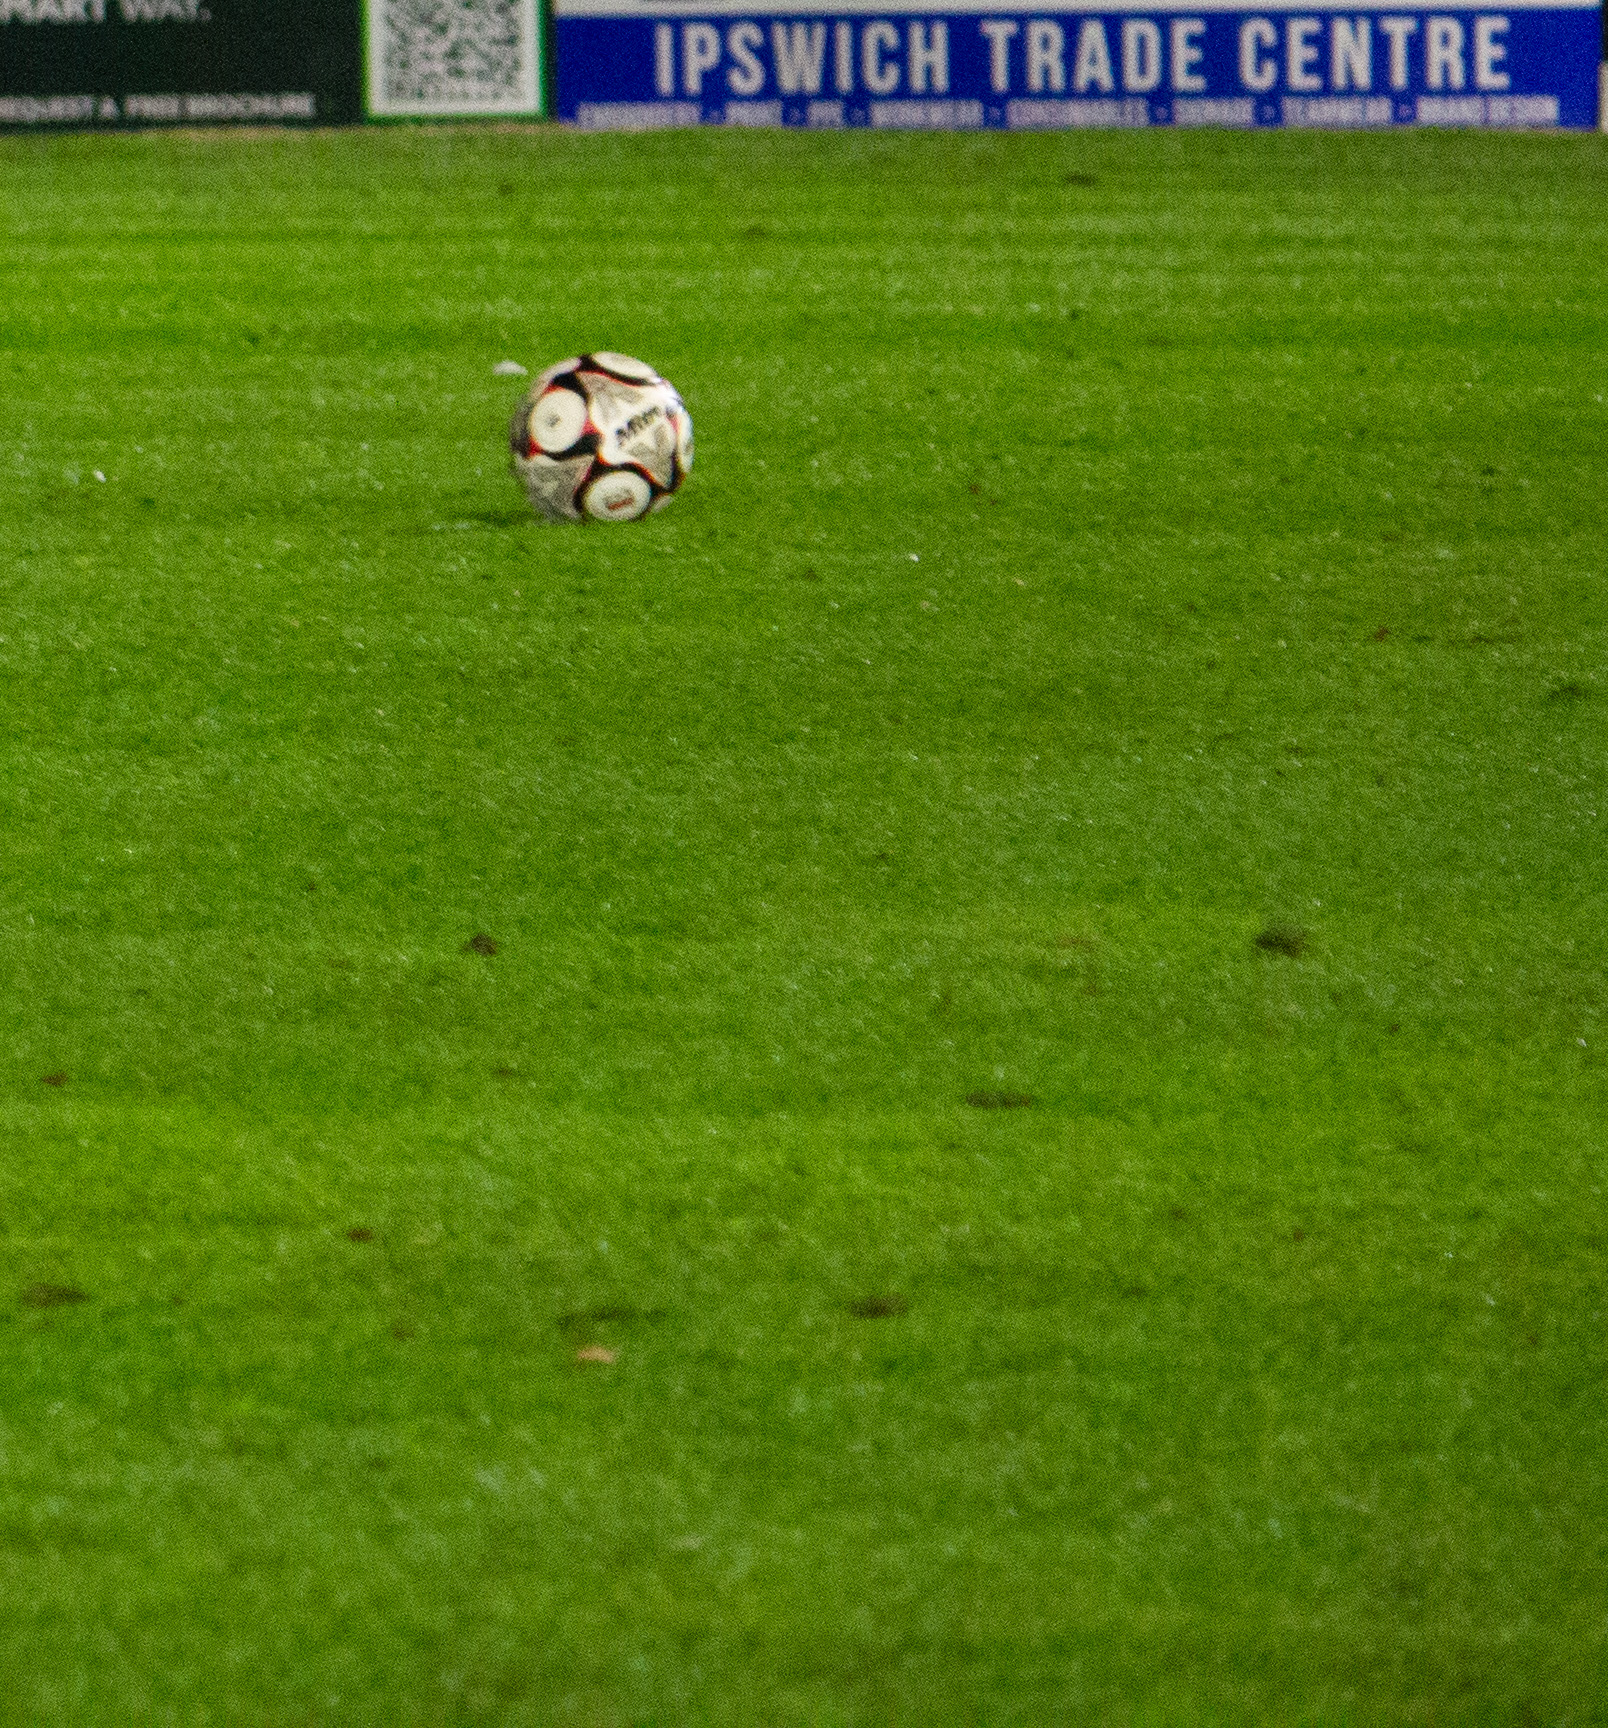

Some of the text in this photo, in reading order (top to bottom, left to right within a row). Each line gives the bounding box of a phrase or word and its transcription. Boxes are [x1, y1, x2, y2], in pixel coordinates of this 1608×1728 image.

[654, 15, 1512, 97] IPSWICH TRADE CENTRE
